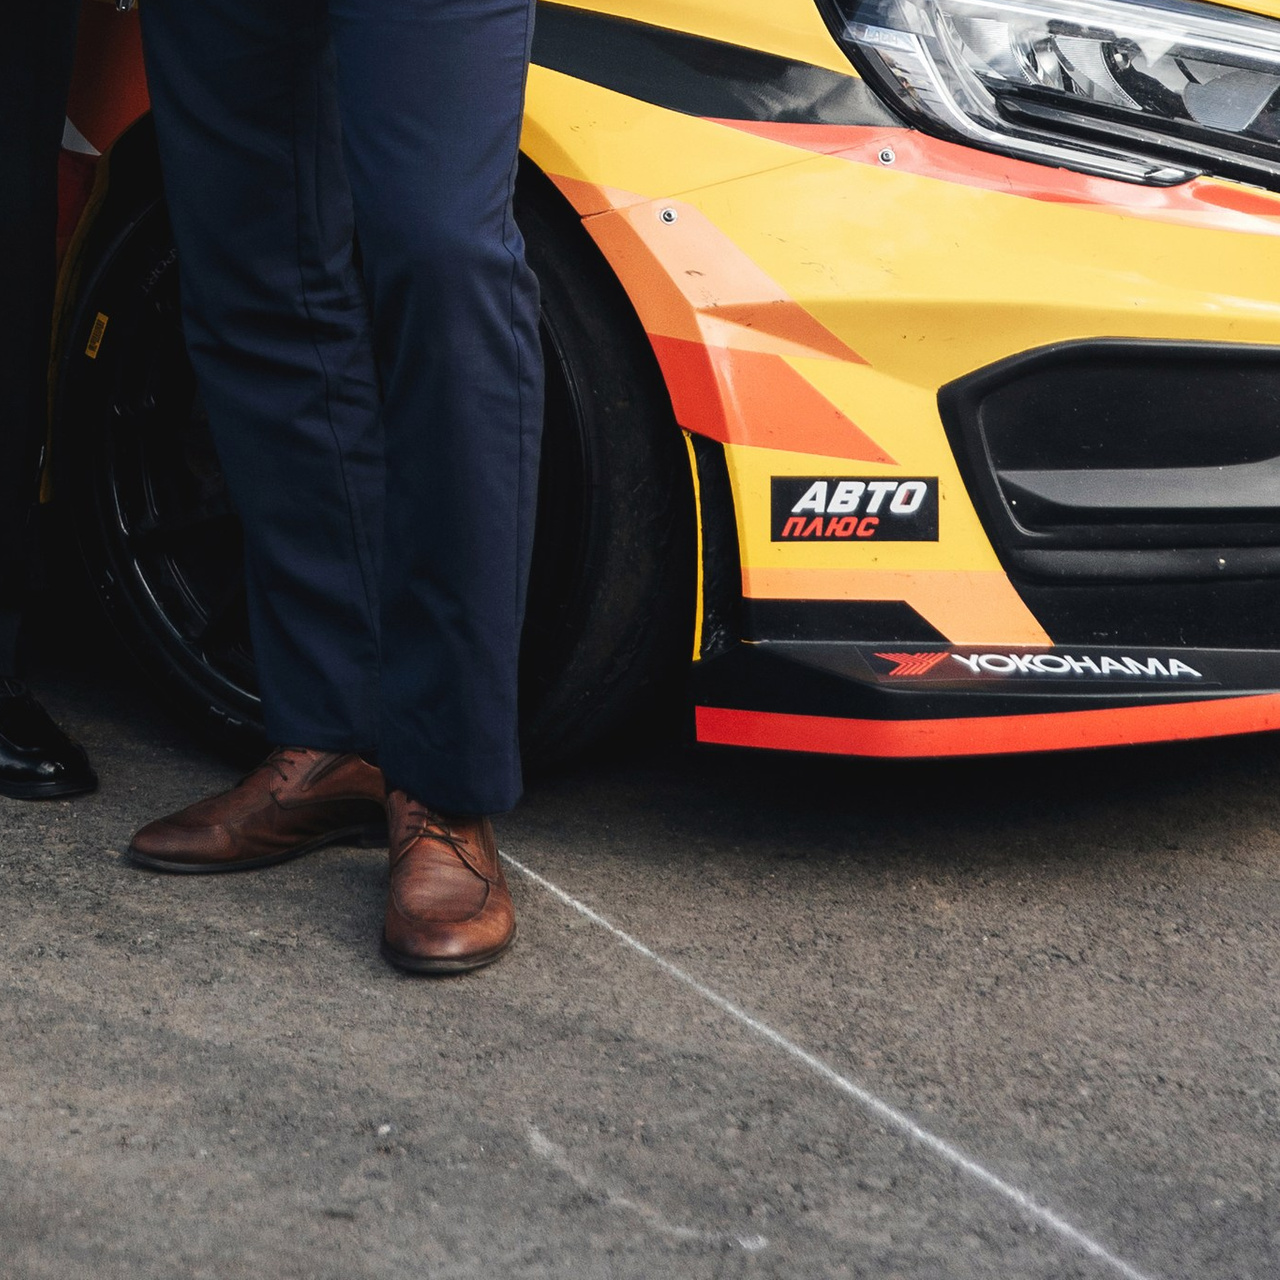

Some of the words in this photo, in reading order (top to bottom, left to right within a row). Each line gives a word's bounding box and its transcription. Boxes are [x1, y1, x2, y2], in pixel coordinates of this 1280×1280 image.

[790, 481, 928, 514] АВТО
[781, 516, 881, 537] ПЛЮС
[951, 653, 1203, 677] YOKOHAMA
